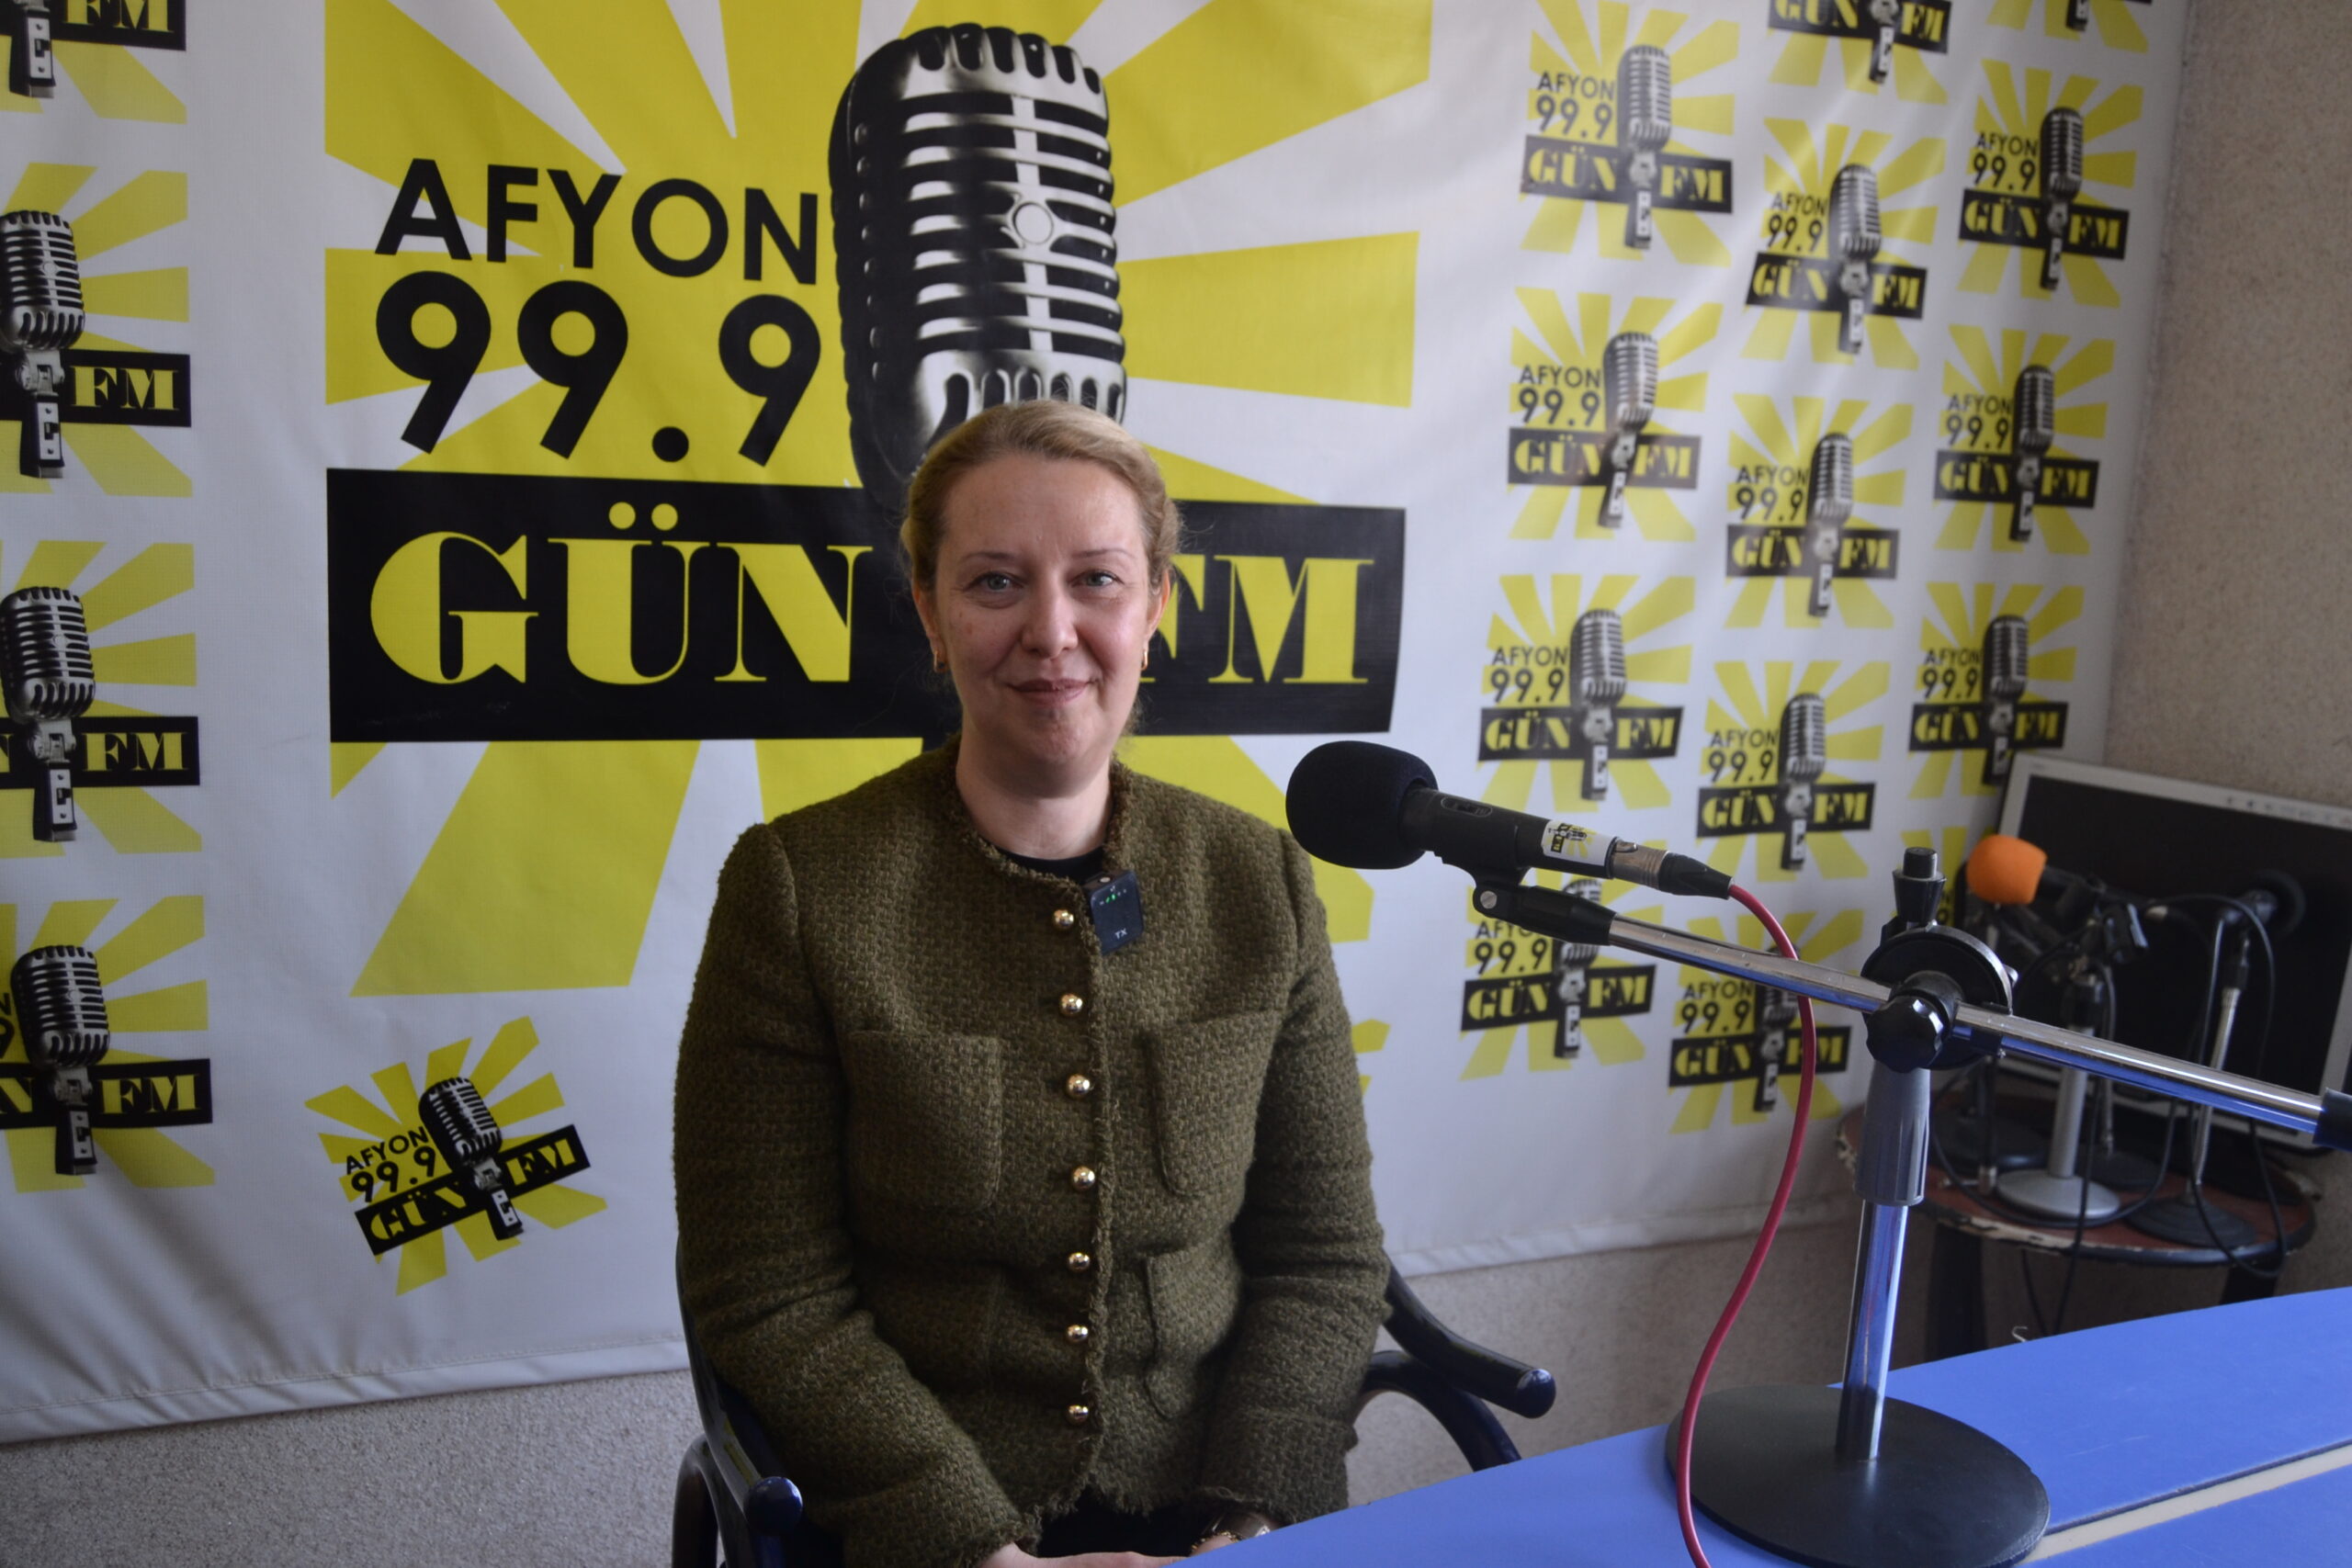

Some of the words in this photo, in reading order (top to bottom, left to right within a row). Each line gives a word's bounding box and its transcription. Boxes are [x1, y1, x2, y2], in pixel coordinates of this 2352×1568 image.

[67, 0, 170, 33] FM
[1902, 2, 1944, 42] FM
[1538, 71, 1614, 101] AFYON
[1536, 95, 1612, 139] 99.9
[1976, 132, 2038, 156] AFYON
[1529, 145, 1617, 191] GÜN
[1659, 164, 1724, 202] FM
[1973, 152, 2036, 191] 99.9
[375, 158, 819, 285] AFYON
[1771, 191, 1827, 217] AFYON
[1964, 197, 2039, 239] GÜN
[2069, 214, 2120, 249] FM
[1768, 214, 1823, 253] 99.9
[1752, 259, 1829, 301] GÜN
[1872, 274, 1920, 309] FM
[376, 270, 821, 467] 99.9
[1519, 365, 1601, 389] AFYON
[71, 366, 179, 411] FM
[1519, 387, 1600, 427] 99.9
[1948, 394, 2012, 414] AFYON
[1946, 414, 2009, 449] 99.9
[1514, 434, 1606, 476] GÜN
[1634, 445, 1691, 478] FM
[1736, 465, 1809, 487] AFYON
[1939, 457, 2010, 494] GÜN
[2041, 467, 2090, 499] FM
[1736, 487, 1804, 522] 99.9
[1732, 529, 1805, 569] GÜN
[1839, 537, 1892, 569] FM
[370, 502, 873, 684] GÜN
[1491, 645, 1569, 667] AFYON
[1924, 649, 1982, 666] AFYON
[1490, 668, 1566, 703] 99.9
[1922, 668, 1979, 699] 99.9
[1485, 710, 1573, 751] GÜN
[1616, 716, 1676, 750] FM
[1710, 728, 1780, 749] AFYON
[1914, 706, 1980, 743] GÜN
[2014, 712, 2059, 740] FM
[83, 732, 189, 772] FM
[1708, 750, 1774, 784] 99.9
[1702, 790, 1778, 829] GÜN
[1814, 792, 1869, 823] FM
[1114, 928, 1127, 940] TX
[1475, 938, 1548, 975] 99.9
[1467, 980, 1551, 1020] GÜN
[1589, 976, 1648, 1008] FM
[1683, 979, 1753, 1000] AFYON
[1681, 999, 1750, 1033] 99.9
[1675, 1040, 1752, 1077] GÜN
[97, 1073, 200, 1115] FM
[345, 1126, 430, 1175] AFYON
[350, 1145, 436, 1203] 99.9
[370, 1181, 467, 1240] GÜN
[505, 1138, 576, 1187] FM
